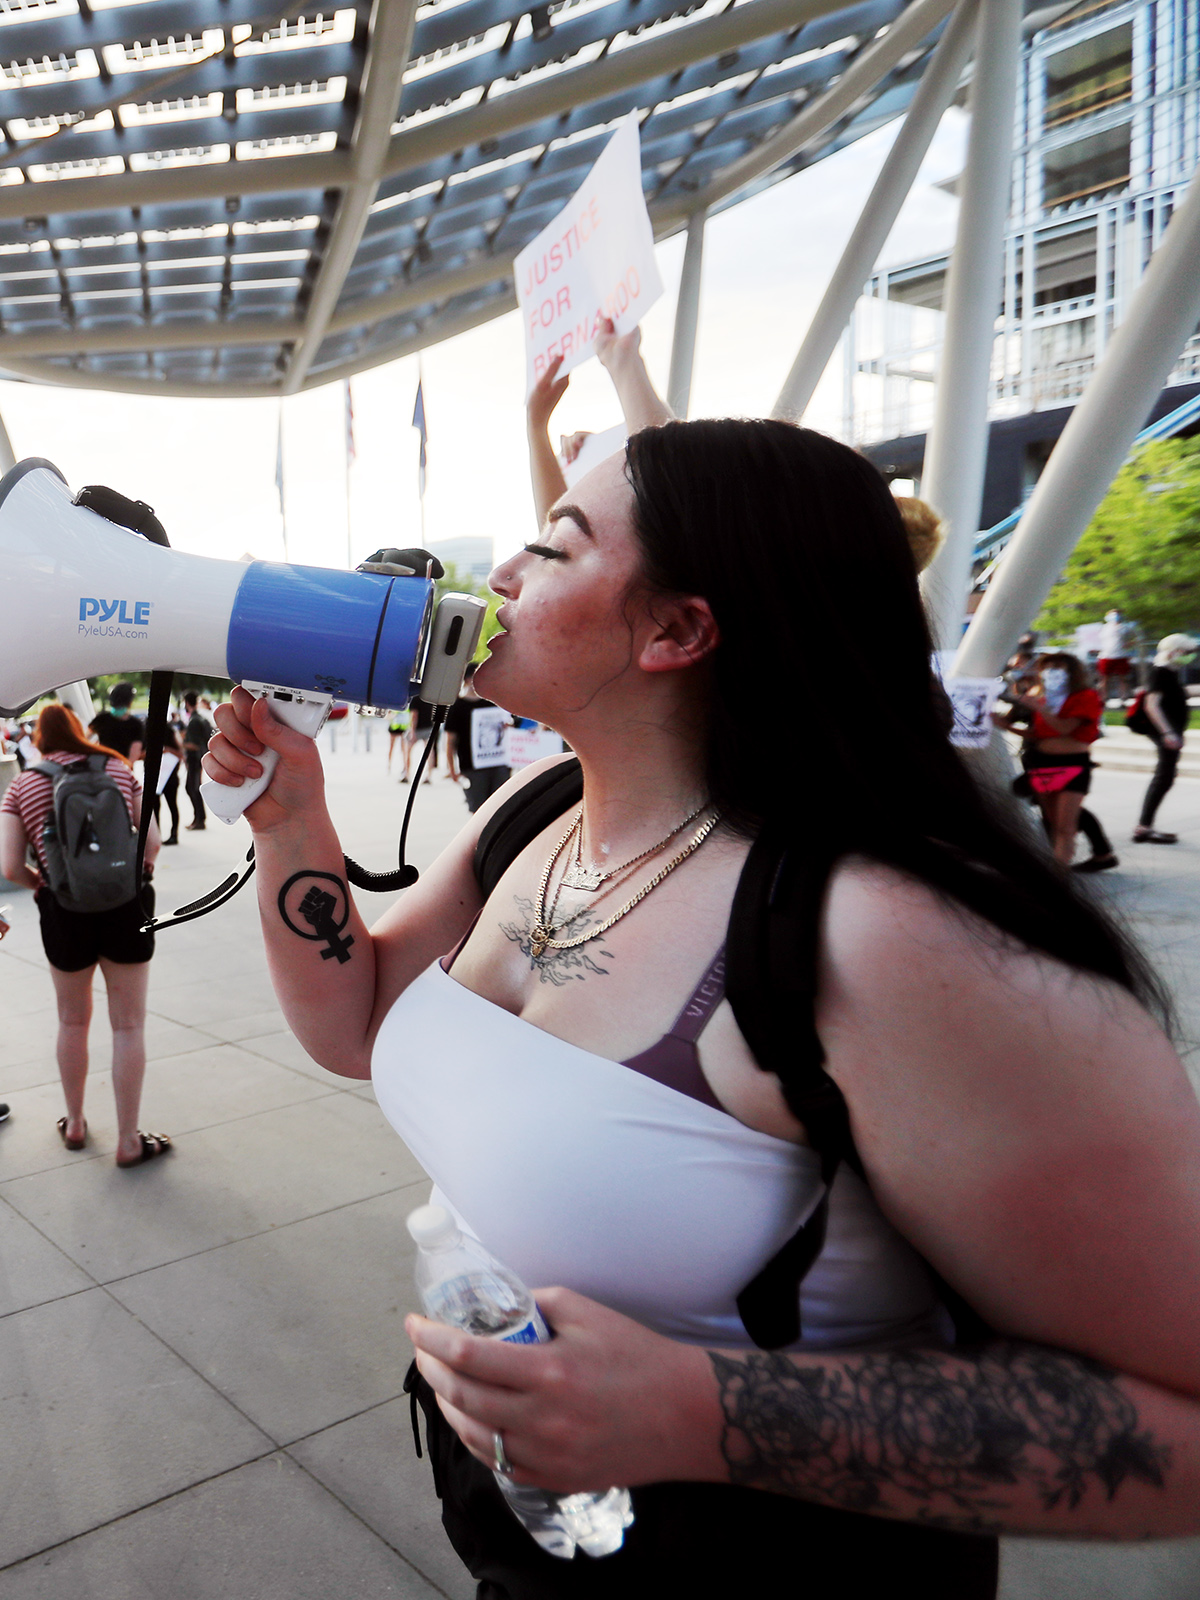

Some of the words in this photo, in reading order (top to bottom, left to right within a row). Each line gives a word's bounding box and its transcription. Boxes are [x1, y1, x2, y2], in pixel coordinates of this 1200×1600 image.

[525, 195, 601, 296] JUSTICE
[529, 285, 571, 340] FOR
[78, 624, 148, 639] PyleUSA.com
[79, 598, 150, 625] PYLE
